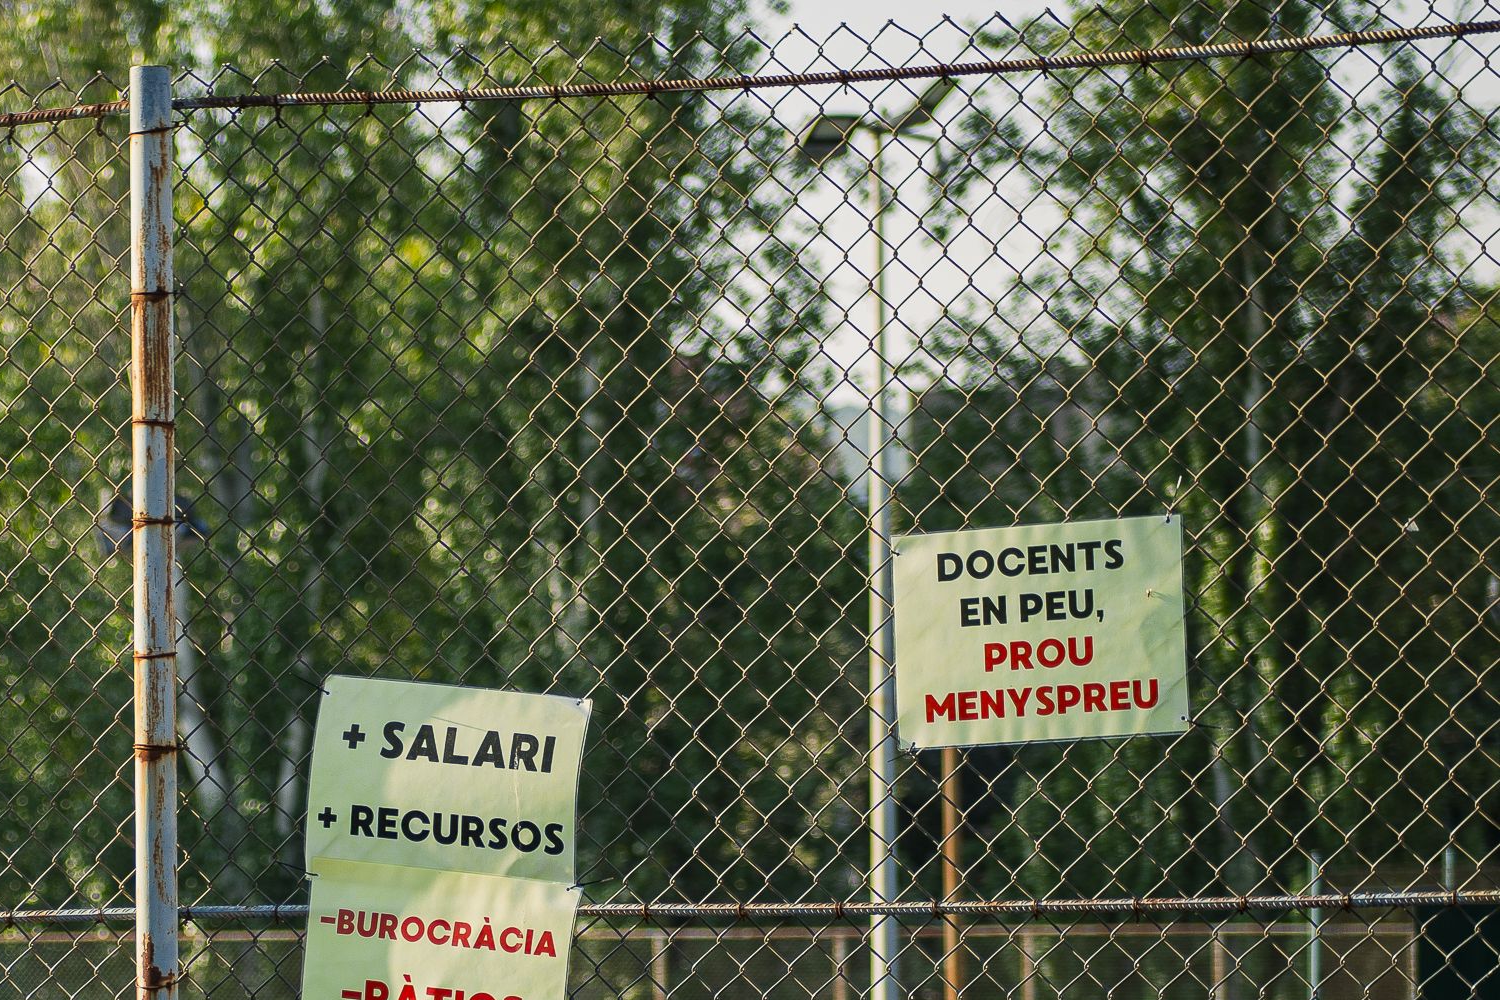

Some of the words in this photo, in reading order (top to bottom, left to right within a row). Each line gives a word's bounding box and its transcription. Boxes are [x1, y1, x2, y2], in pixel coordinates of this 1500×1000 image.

[936, 539, 1125, 582] DOCENTS
[960, 595, 1007, 627] EN
[1019, 588, 1105, 623] PEU,
[984, 635, 1093, 672] PROU
[924, 678, 1159, 723] MENYSPREU
[342, 723, 366, 750] +
[379, 721, 557, 774] SALARI
[317, 806, 337, 829] +
[349, 804, 564, 856] RECURSOS
